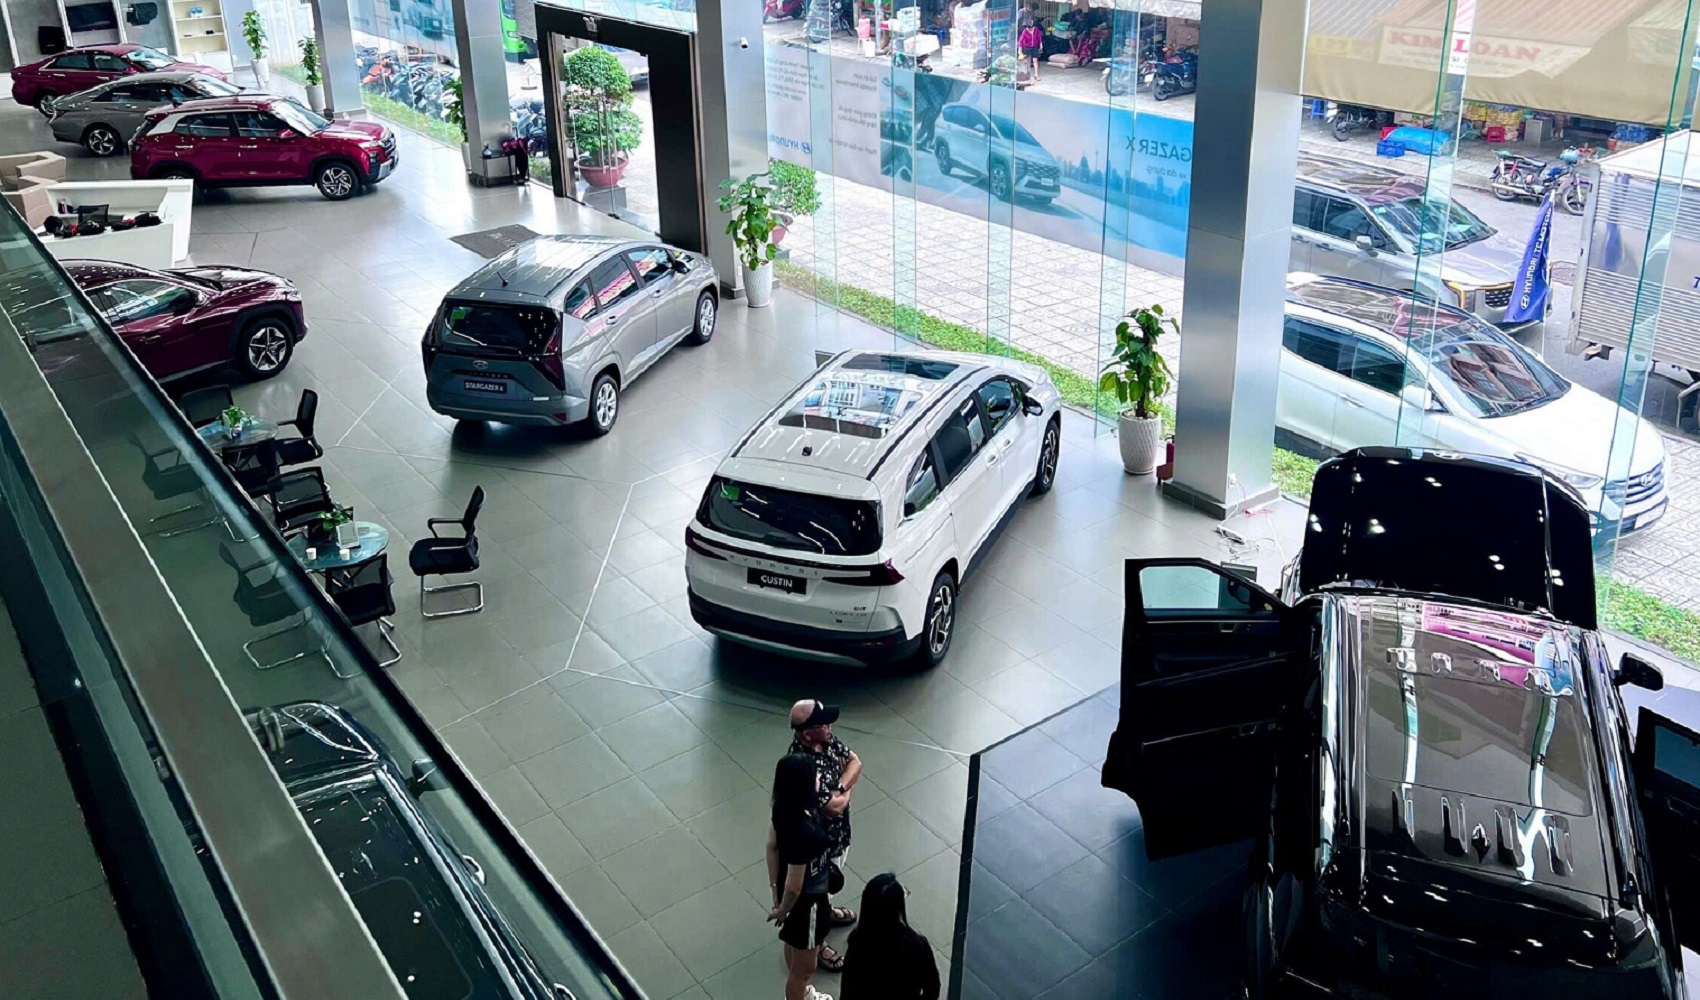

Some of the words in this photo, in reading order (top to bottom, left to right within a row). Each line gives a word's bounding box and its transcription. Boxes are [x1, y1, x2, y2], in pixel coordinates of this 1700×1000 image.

[1389, 31, 1441, 49] KIM
[1453, 38, 1541, 61] LOAN
[1524, 258, 1538, 293] HYUNDAI
[760, 574, 793, 588] CUSTIN
